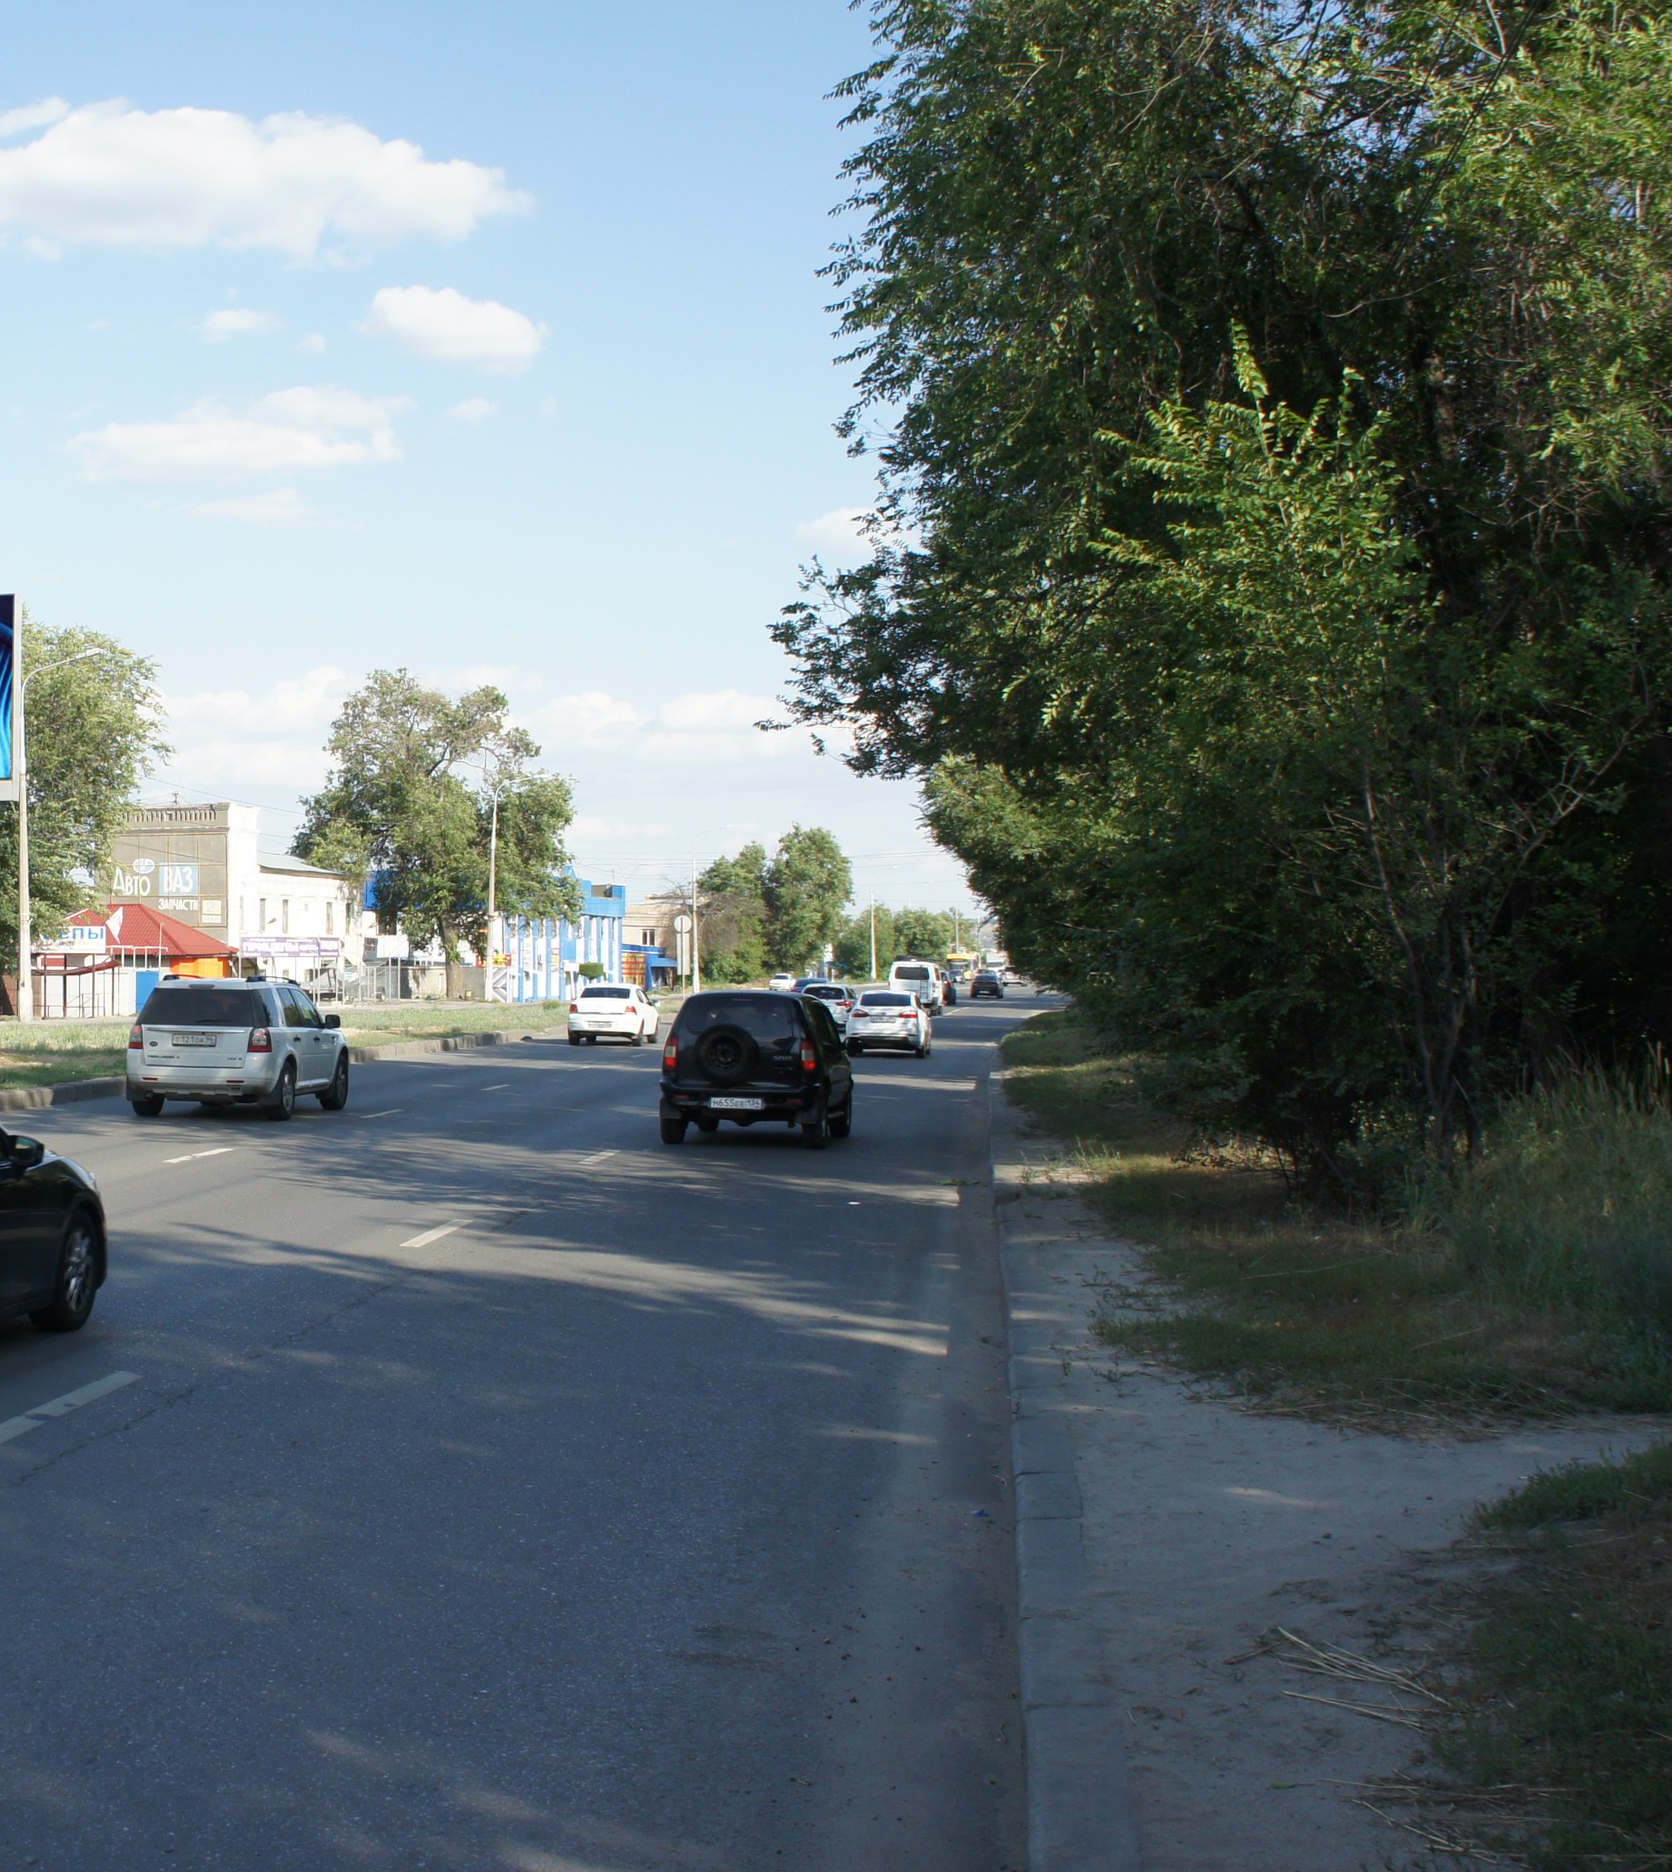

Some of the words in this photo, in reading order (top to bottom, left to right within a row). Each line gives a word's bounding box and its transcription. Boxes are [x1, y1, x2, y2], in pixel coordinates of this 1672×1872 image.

[163, 866, 193, 893] ВАЗ
[158, 898, 199, 911] ЗАПЧАСТИ
[242, 941, 299, 952] ПРИЦЕПЫ
